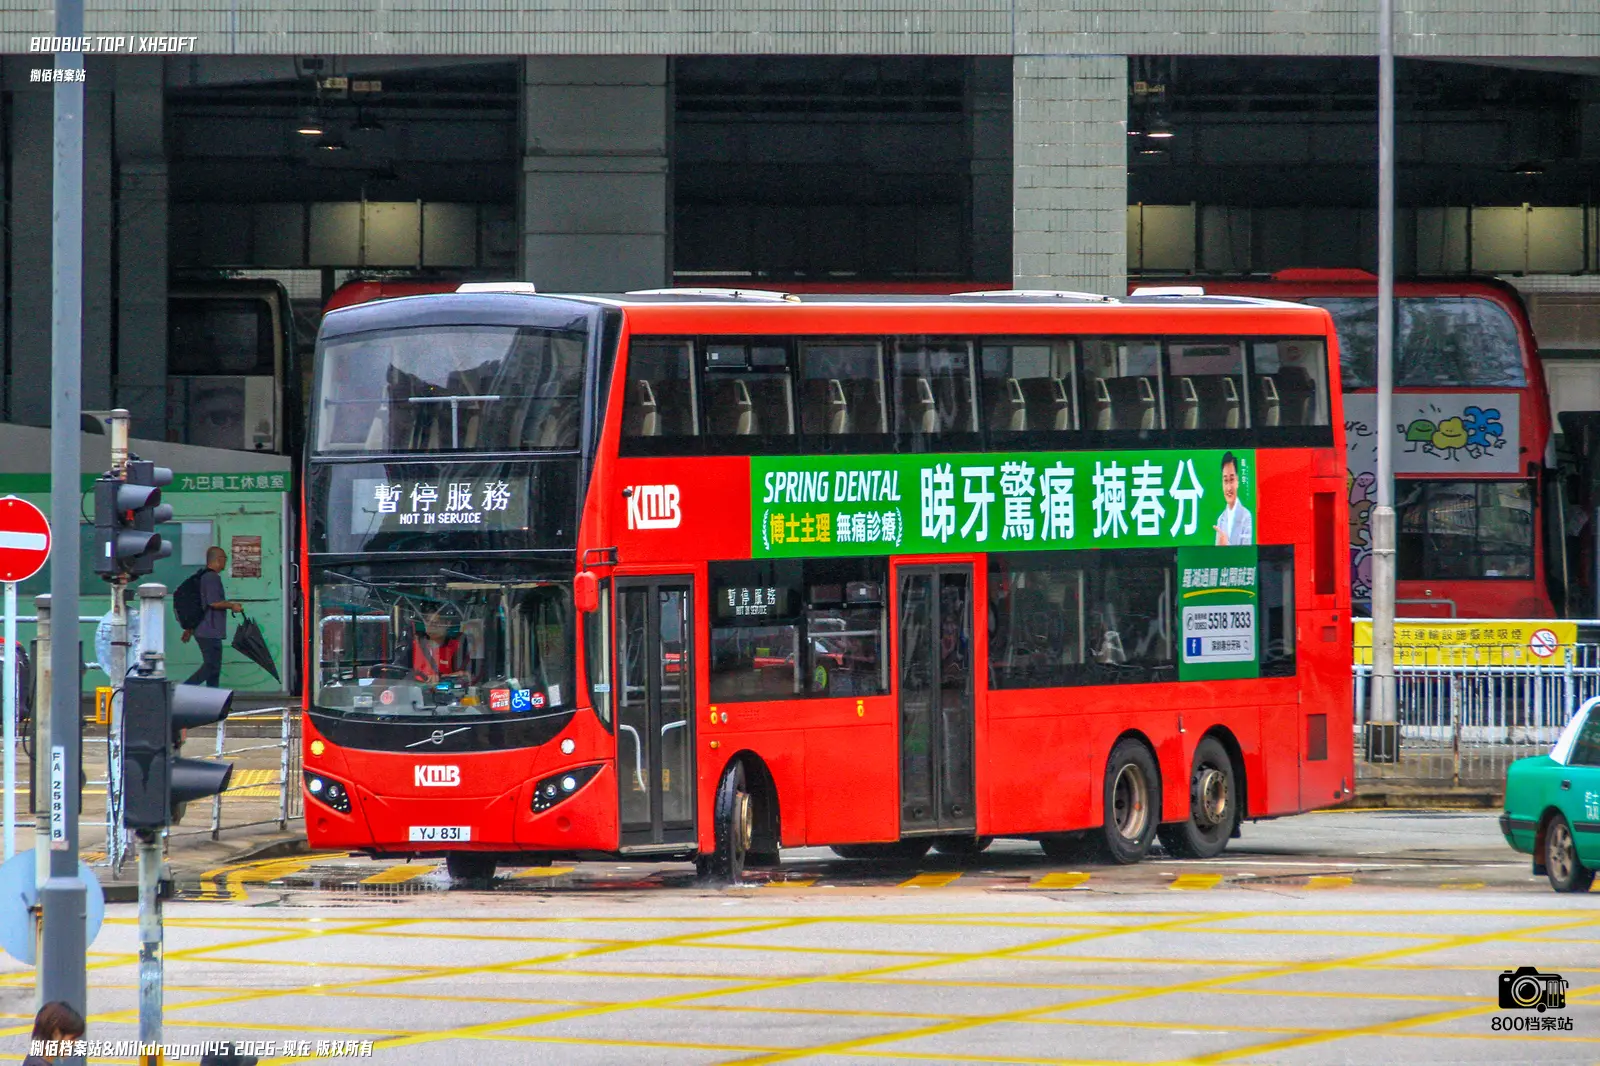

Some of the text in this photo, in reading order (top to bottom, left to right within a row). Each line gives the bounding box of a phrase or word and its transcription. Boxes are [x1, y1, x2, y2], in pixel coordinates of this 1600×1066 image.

[181, 475, 284, 491] 九巴員工休息室
[763, 470, 902, 503] SPRING DENTAL
[374, 480, 511, 513] 暫停服務
[626, 484, 682, 530] KMB
[920, 461, 1075, 543] 睇牙驚痛
[1092, 459, 1205, 539] 揀春分
[400, 512, 482, 525] NOT IN SERVICE
[770, 511, 897, 544] 博士主理 無痛診療
[1208, 612, 1228, 630] 5518
[1230, 611, 1251, 629] 7833
[1393, 628, 1523, 641] 共運輸設施嚴禁吸煙
[414, 765, 461, 787] KMB
[419, 827, 461, 839] YJ 831
